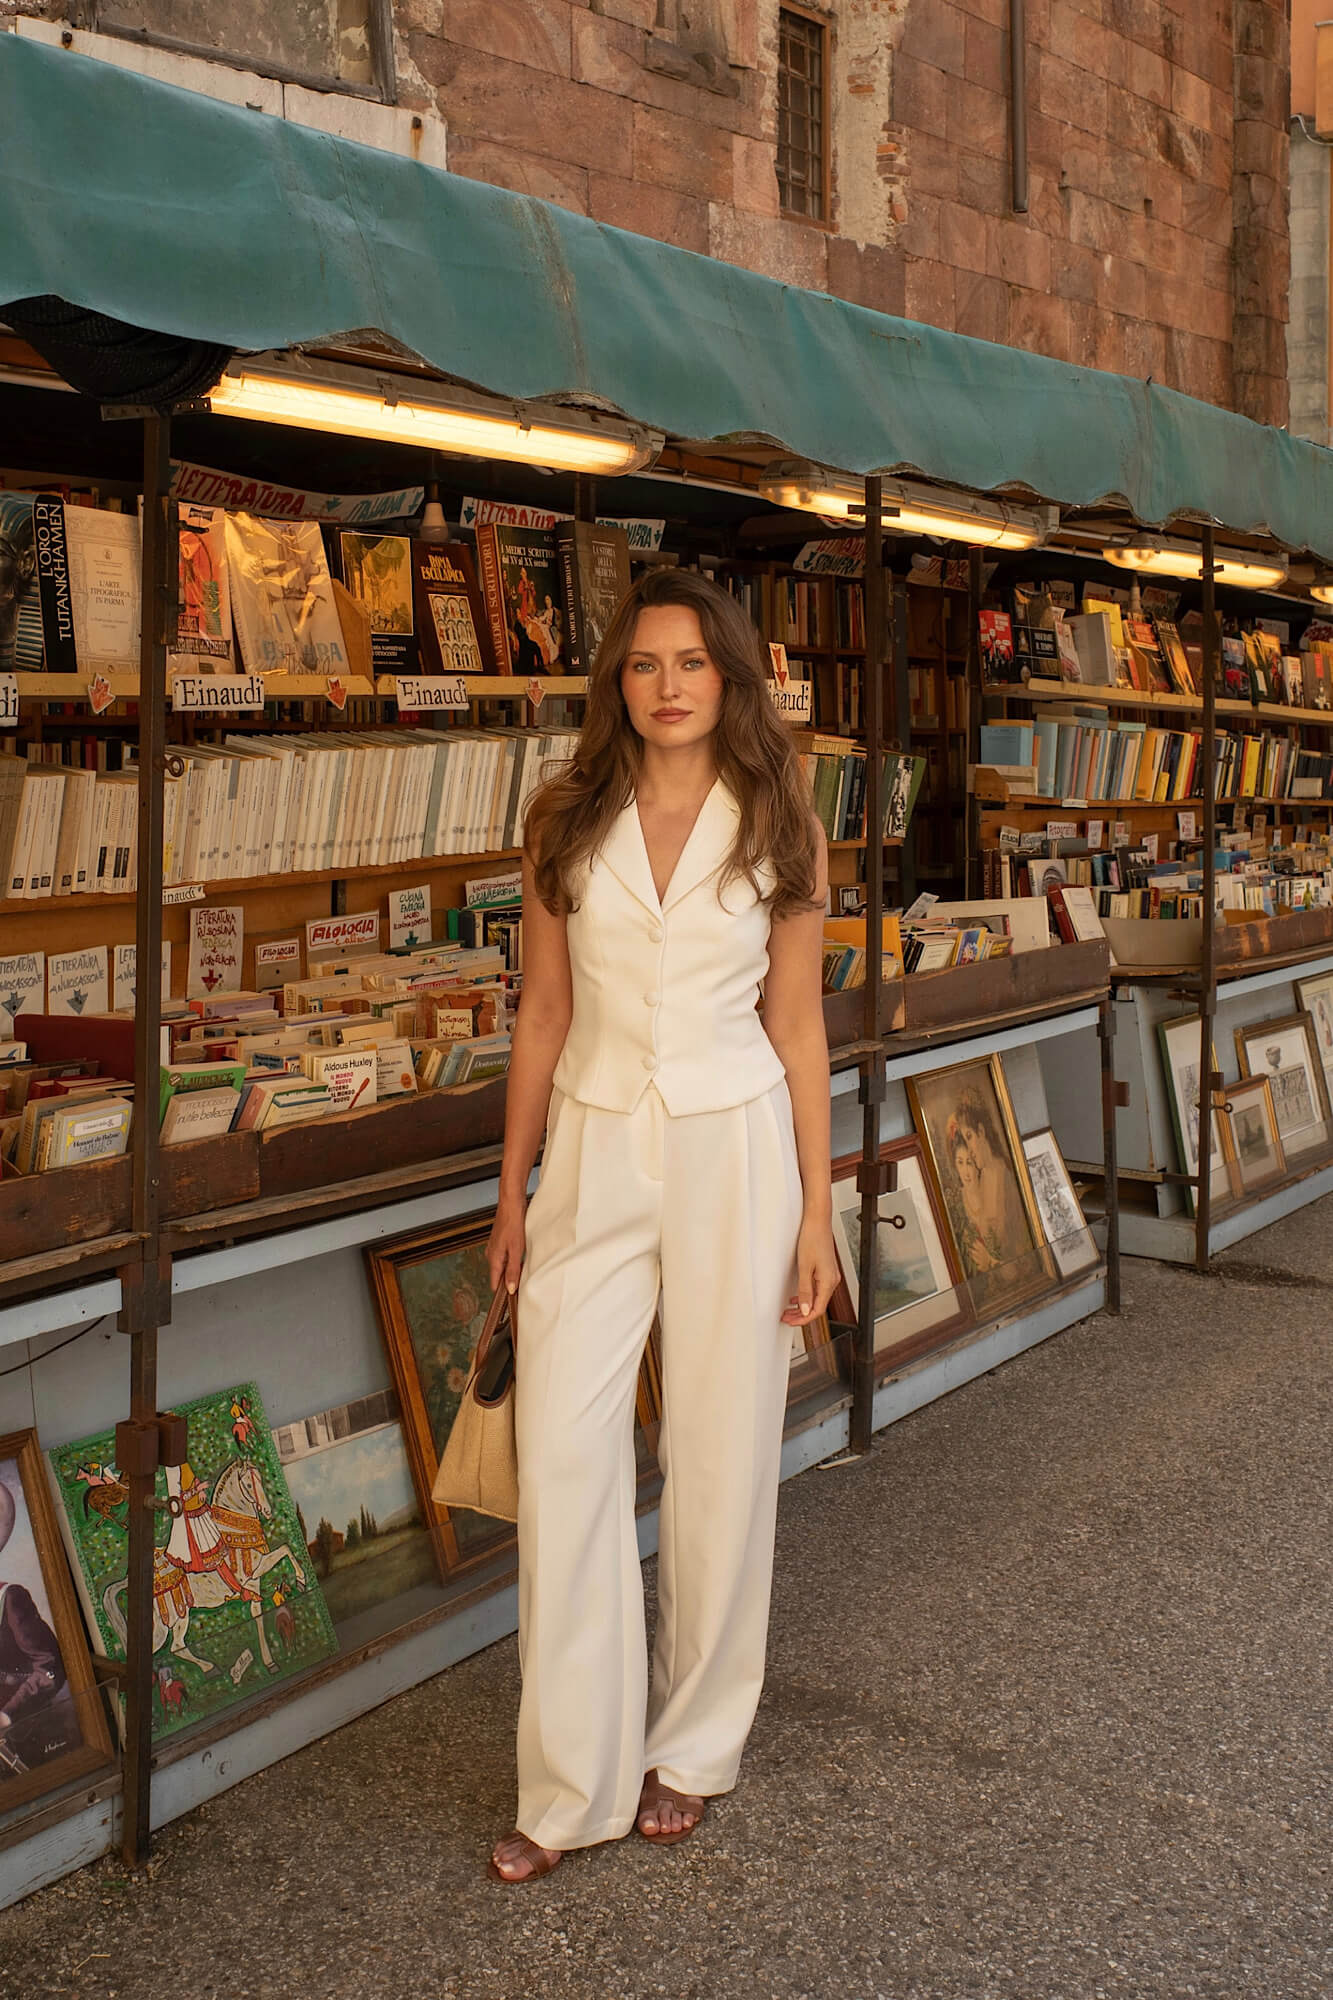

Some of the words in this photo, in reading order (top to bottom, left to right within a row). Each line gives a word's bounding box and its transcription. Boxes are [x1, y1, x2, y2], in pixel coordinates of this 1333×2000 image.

[176, 466, 306, 515] LETTERATURA
[36, 503, 49, 520] DI
[475, 500, 566, 530] LETTERATUR
[38, 526, 54, 577] L'ORO
[428, 554, 452, 569] ROMA
[504, 545, 527, 556] MEDICI
[598, 558, 613, 566] DELLA
[599, 546, 615, 557] STORIA
[50, 503, 72, 641] TUTANKHAMEN
[482, 543, 498, 608] SCRITTORI
[595, 566, 617, 578] MEDICINA
[490, 613, 504, 657] MEDICI
[568, 610, 577, 645] MEDICINA
[180, 676, 262, 706] Einaudi
[400, 678, 468, 706] Einaudi
[769, 684, 809, 711] naudi
[163, 887, 196, 904] inaudi
[312, 920, 374, 942] FILOLOGIA
[0, 954, 38, 978] TTERATURA
[51, 952, 100, 977] LETTERATURA
[324, 1062, 348, 1072] Aldous
[350, 1056, 373, 1068] Huxley
